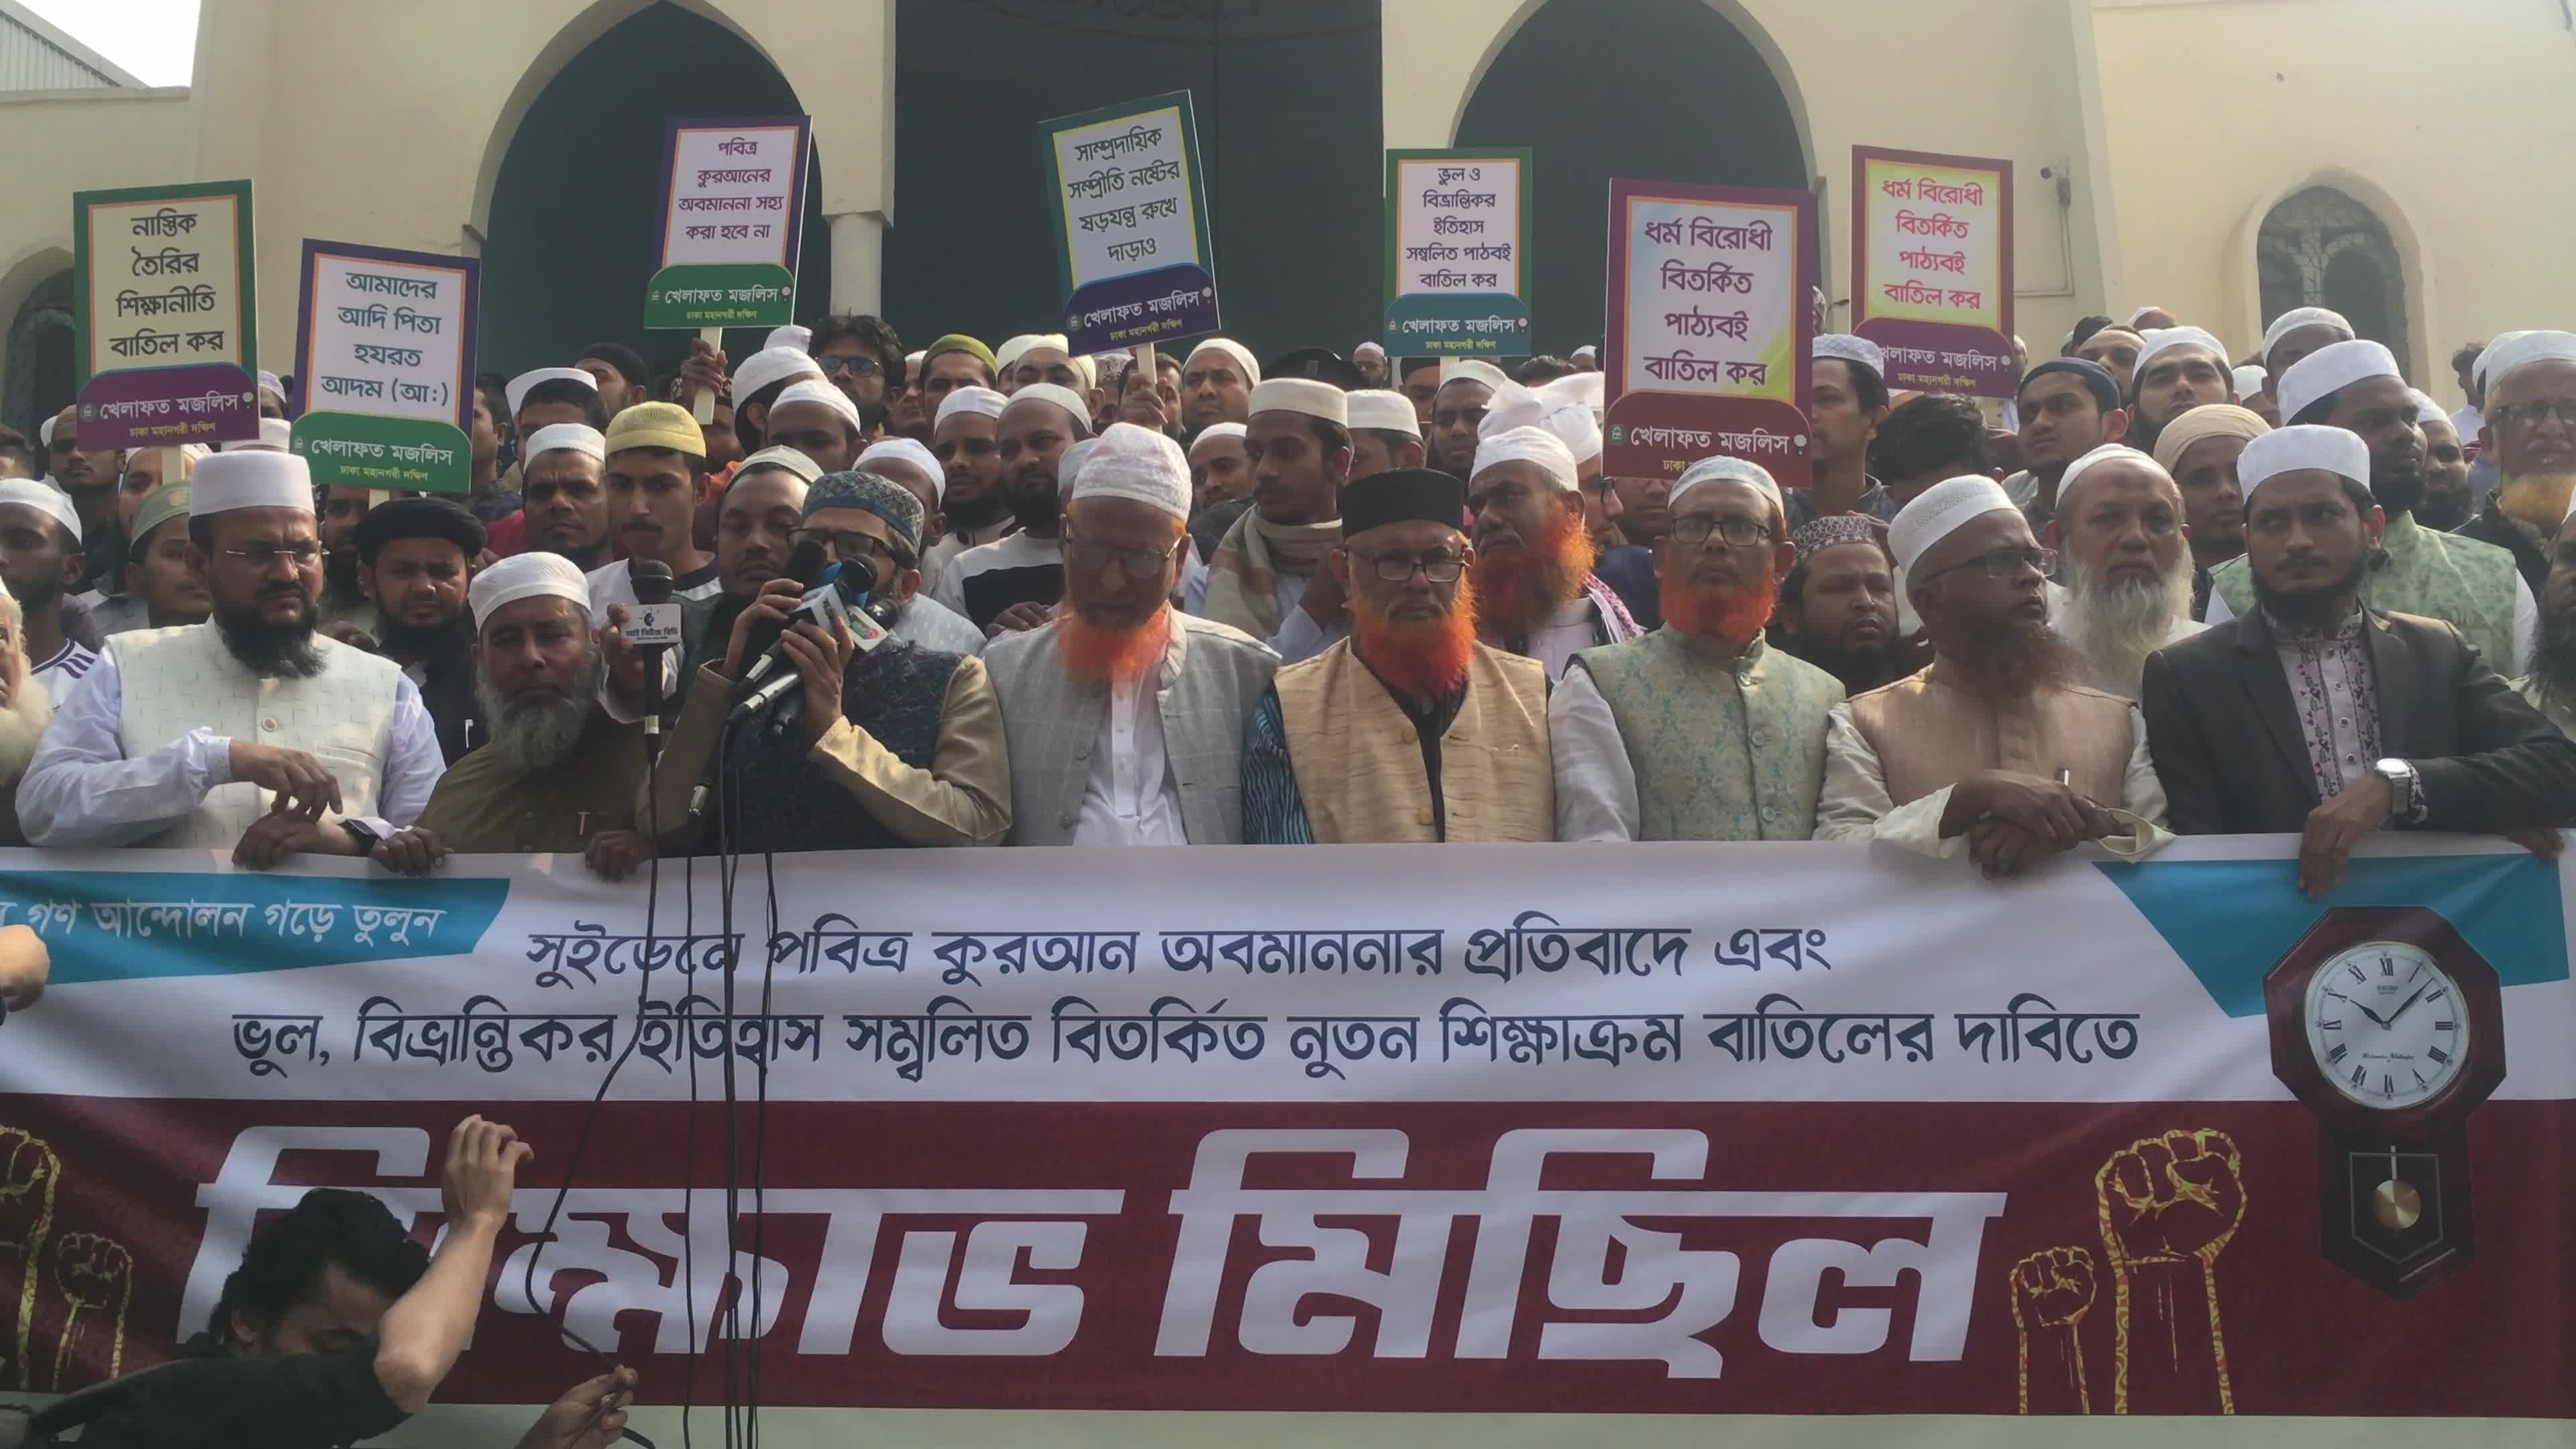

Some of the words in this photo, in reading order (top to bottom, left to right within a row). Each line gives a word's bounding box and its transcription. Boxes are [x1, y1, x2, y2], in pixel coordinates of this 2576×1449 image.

[718, 137, 758, 156] পবিত্র
[1075, 126, 1162, 161] সাম্প্রদায়িক
[698, 168, 771, 188] কুরআনের
[1067, 168, 1124, 198] সম্প্রীতি
[1128, 159, 1180, 185] নষ্টের
[1438, 168, 1465, 186] ভুল
[1469, 168, 1481, 181] ও
[679, 197, 752, 211] অবমাননা
[756, 196, 784, 211] সহ্য
[1423, 189, 1496, 209] বিভ্রান্তিকর
[1882, 178, 1911, 199] ধর্ম
[1917, 177, 1984, 206] বিরোধী
[131, 208, 197, 236] নাস্তিক
[1079, 206, 1136, 232] ষড়যন্ত্র
[1139, 197, 1177, 219] রুখে
[1433, 215, 1485, 235] ইতিহাস
[1896, 209, 1970, 238] বিতর্কিত
[686, 225, 716, 239] করা
[721, 225, 749, 239] হবে
[753, 225, 771, 238] না
[1644, 217, 1682, 245] ধর্ম
[1689, 216, 1772, 251] বিরোধী
[131, 246, 200, 276] তৈরির
[1108, 237, 1157, 262] দাড়াও
[1406, 242, 1458, 262] সম্বলিত
[1464, 242, 1511, 261] পাঠবই
[1900, 246, 1966, 275] পাঠ্যবই
[345, 272, 437, 299] আমাদের
[1419, 269, 1467, 287] বাতিল
[1471, 274, 1497, 287] কর
[1661, 259, 1754, 294] বিতর্কিত
[116, 284, 216, 317] শিক্ষানীতি
[665, 288, 723, 303] খেলাফত
[728, 284, 778, 302] মজলিস
[1884, 280, 1943, 306] বাতিল
[1948, 290, 1980, 309] কর
[337, 303, 388, 329] আদি
[394, 307, 441, 334] পিতা
[1084, 303, 1142, 327] খেলাফত
[1147, 290, 1199, 314] মজলিস
[1402, 318, 1460, 333] খেলাফত
[1464, 315, 1514, 333] মজলিস
[1665, 305, 1749, 341] পাঠ্যবই
[109, 328, 180, 356] বাতিল
[186, 331, 224, 352] কর
[354, 343, 423, 366] হযরত
[1644, 350, 1719, 382] বাতিল
[1726, 362, 1767, 385] কর
[1878, 345, 1936, 364] খলাফত
[1940, 349, 1996, 370] মজলিস
[321, 376, 384, 398] আদম
[101, 400, 170, 419] খেলাফত
[176, 390, 239, 413] মজলিস
[311, 439, 384, 459] খেলাফত
[390, 443, 453, 466] মজলিস
[1631, 426, 1711, 449] খেলাফত
[1718, 427, 1790, 454] মজলিস
[1663, 460, 1685, 472] ঢাকা
[28, 897, 82, 935] গণ
[89, 898, 256, 938] আন্দোলন
[265, 898, 343, 943] গড়ে
[352, 906, 447, 947] তুলুন
[527, 920, 745, 989] সুইডেনে
[766, 913, 912, 973] পবিত্র
[932, 931, 1140, 987] কুরআন
[1159, 929, 1444, 975] অবমাননার
[1464, 910, 1691, 983] প্রতিবাদে
[1714, 928, 1831, 971] এবং
[354, 995, 617, 1073] বিভ্রান্তিকর
[637, 995, 824, 1073] ইতিহাস
[844, 995, 1032, 1083] সম্বলিত
[1051, 996, 1267, 1063] বিতর্কিত
[1287, 1016, 1420, 1080] নুতন
[1439, 996, 1683, 1067] শিক্ষাক্রম
[1703, 993, 1934, 1063] বাতিলের
[1954, 992, 2140, 1064] দাবিতে
[1152, 1128, 2008, 1379] মিছিল
